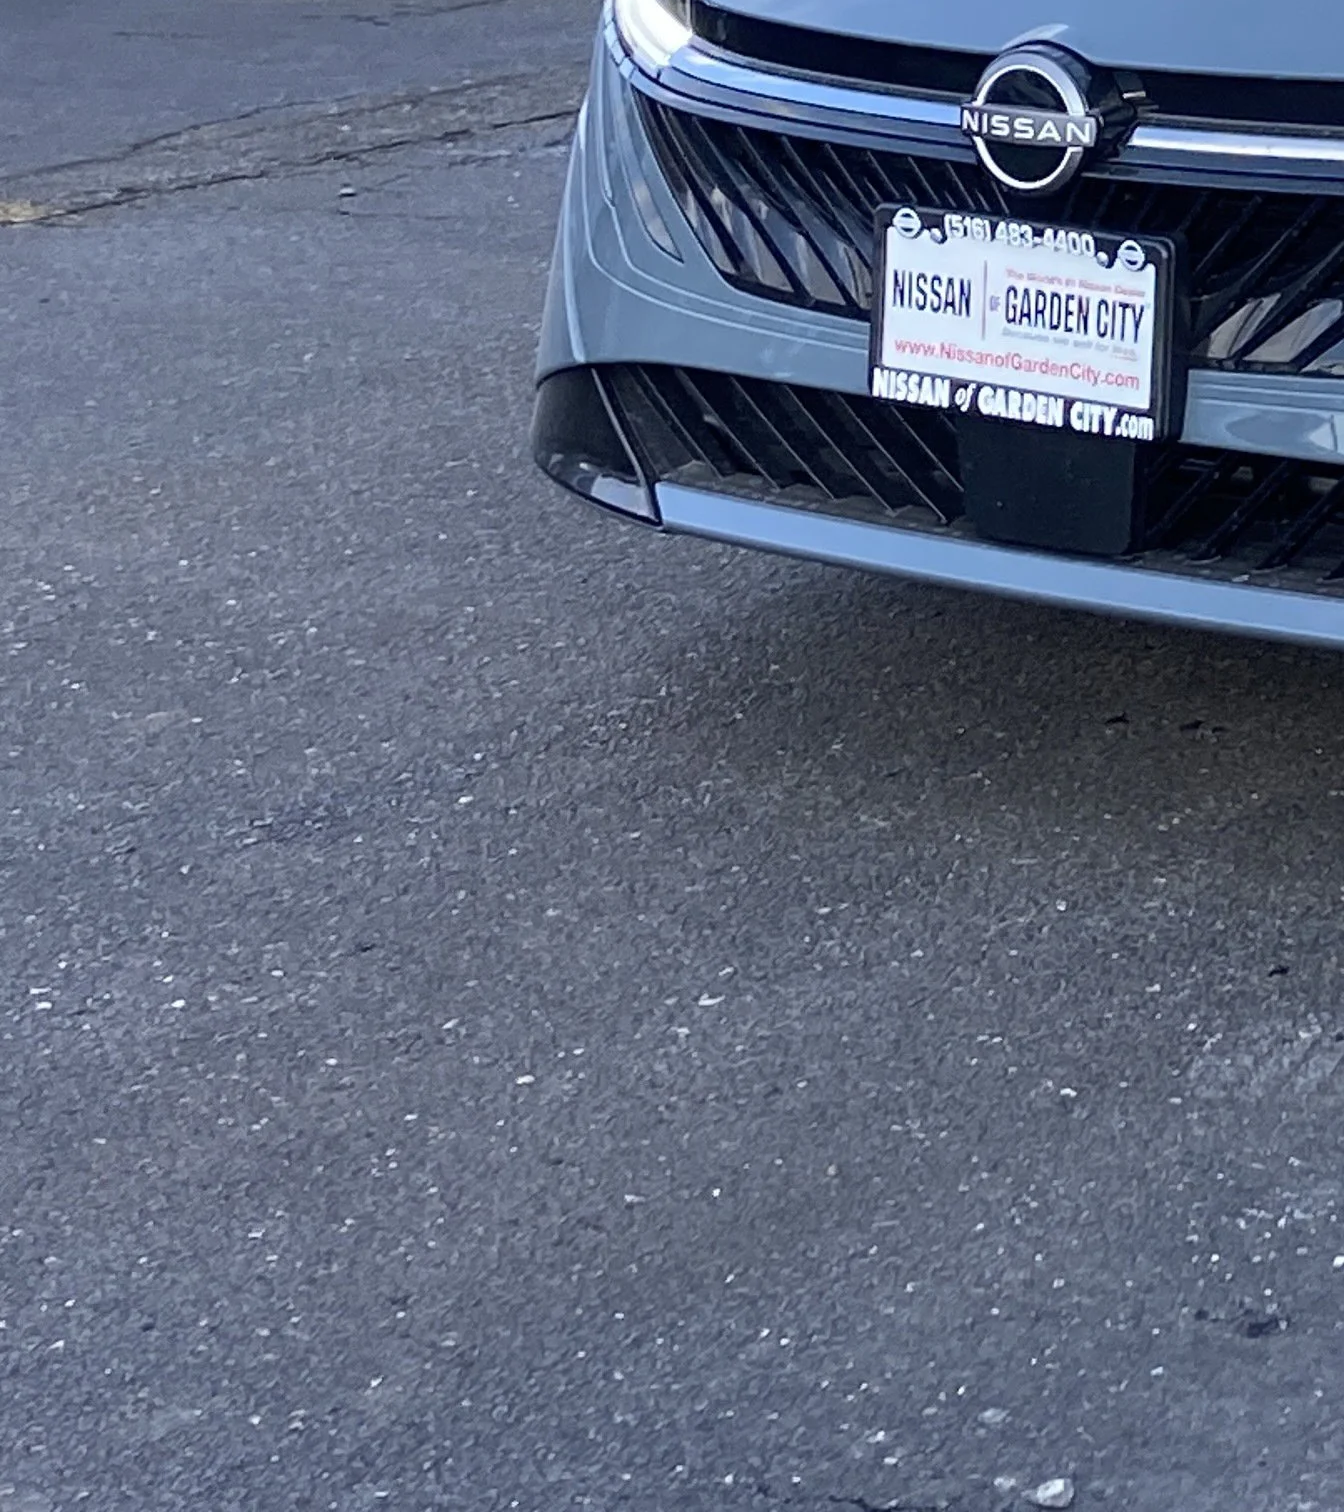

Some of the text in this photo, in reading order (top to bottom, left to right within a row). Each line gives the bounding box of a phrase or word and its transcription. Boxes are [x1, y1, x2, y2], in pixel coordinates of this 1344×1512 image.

[962, 109, 1091, 144] NISSAN
[944, 214, 1096, 257] (516) 483-4400
[893, 269, 972, 317] NISSAN
[1005, 285, 1090, 335] GARDEN
[1097, 299, 1145, 344] CITY
[895, 338, 1140, 390] www.NissanofGardenCity.com
[872, 366, 1154, 441] NISSAN of GARDEN CITY.com
